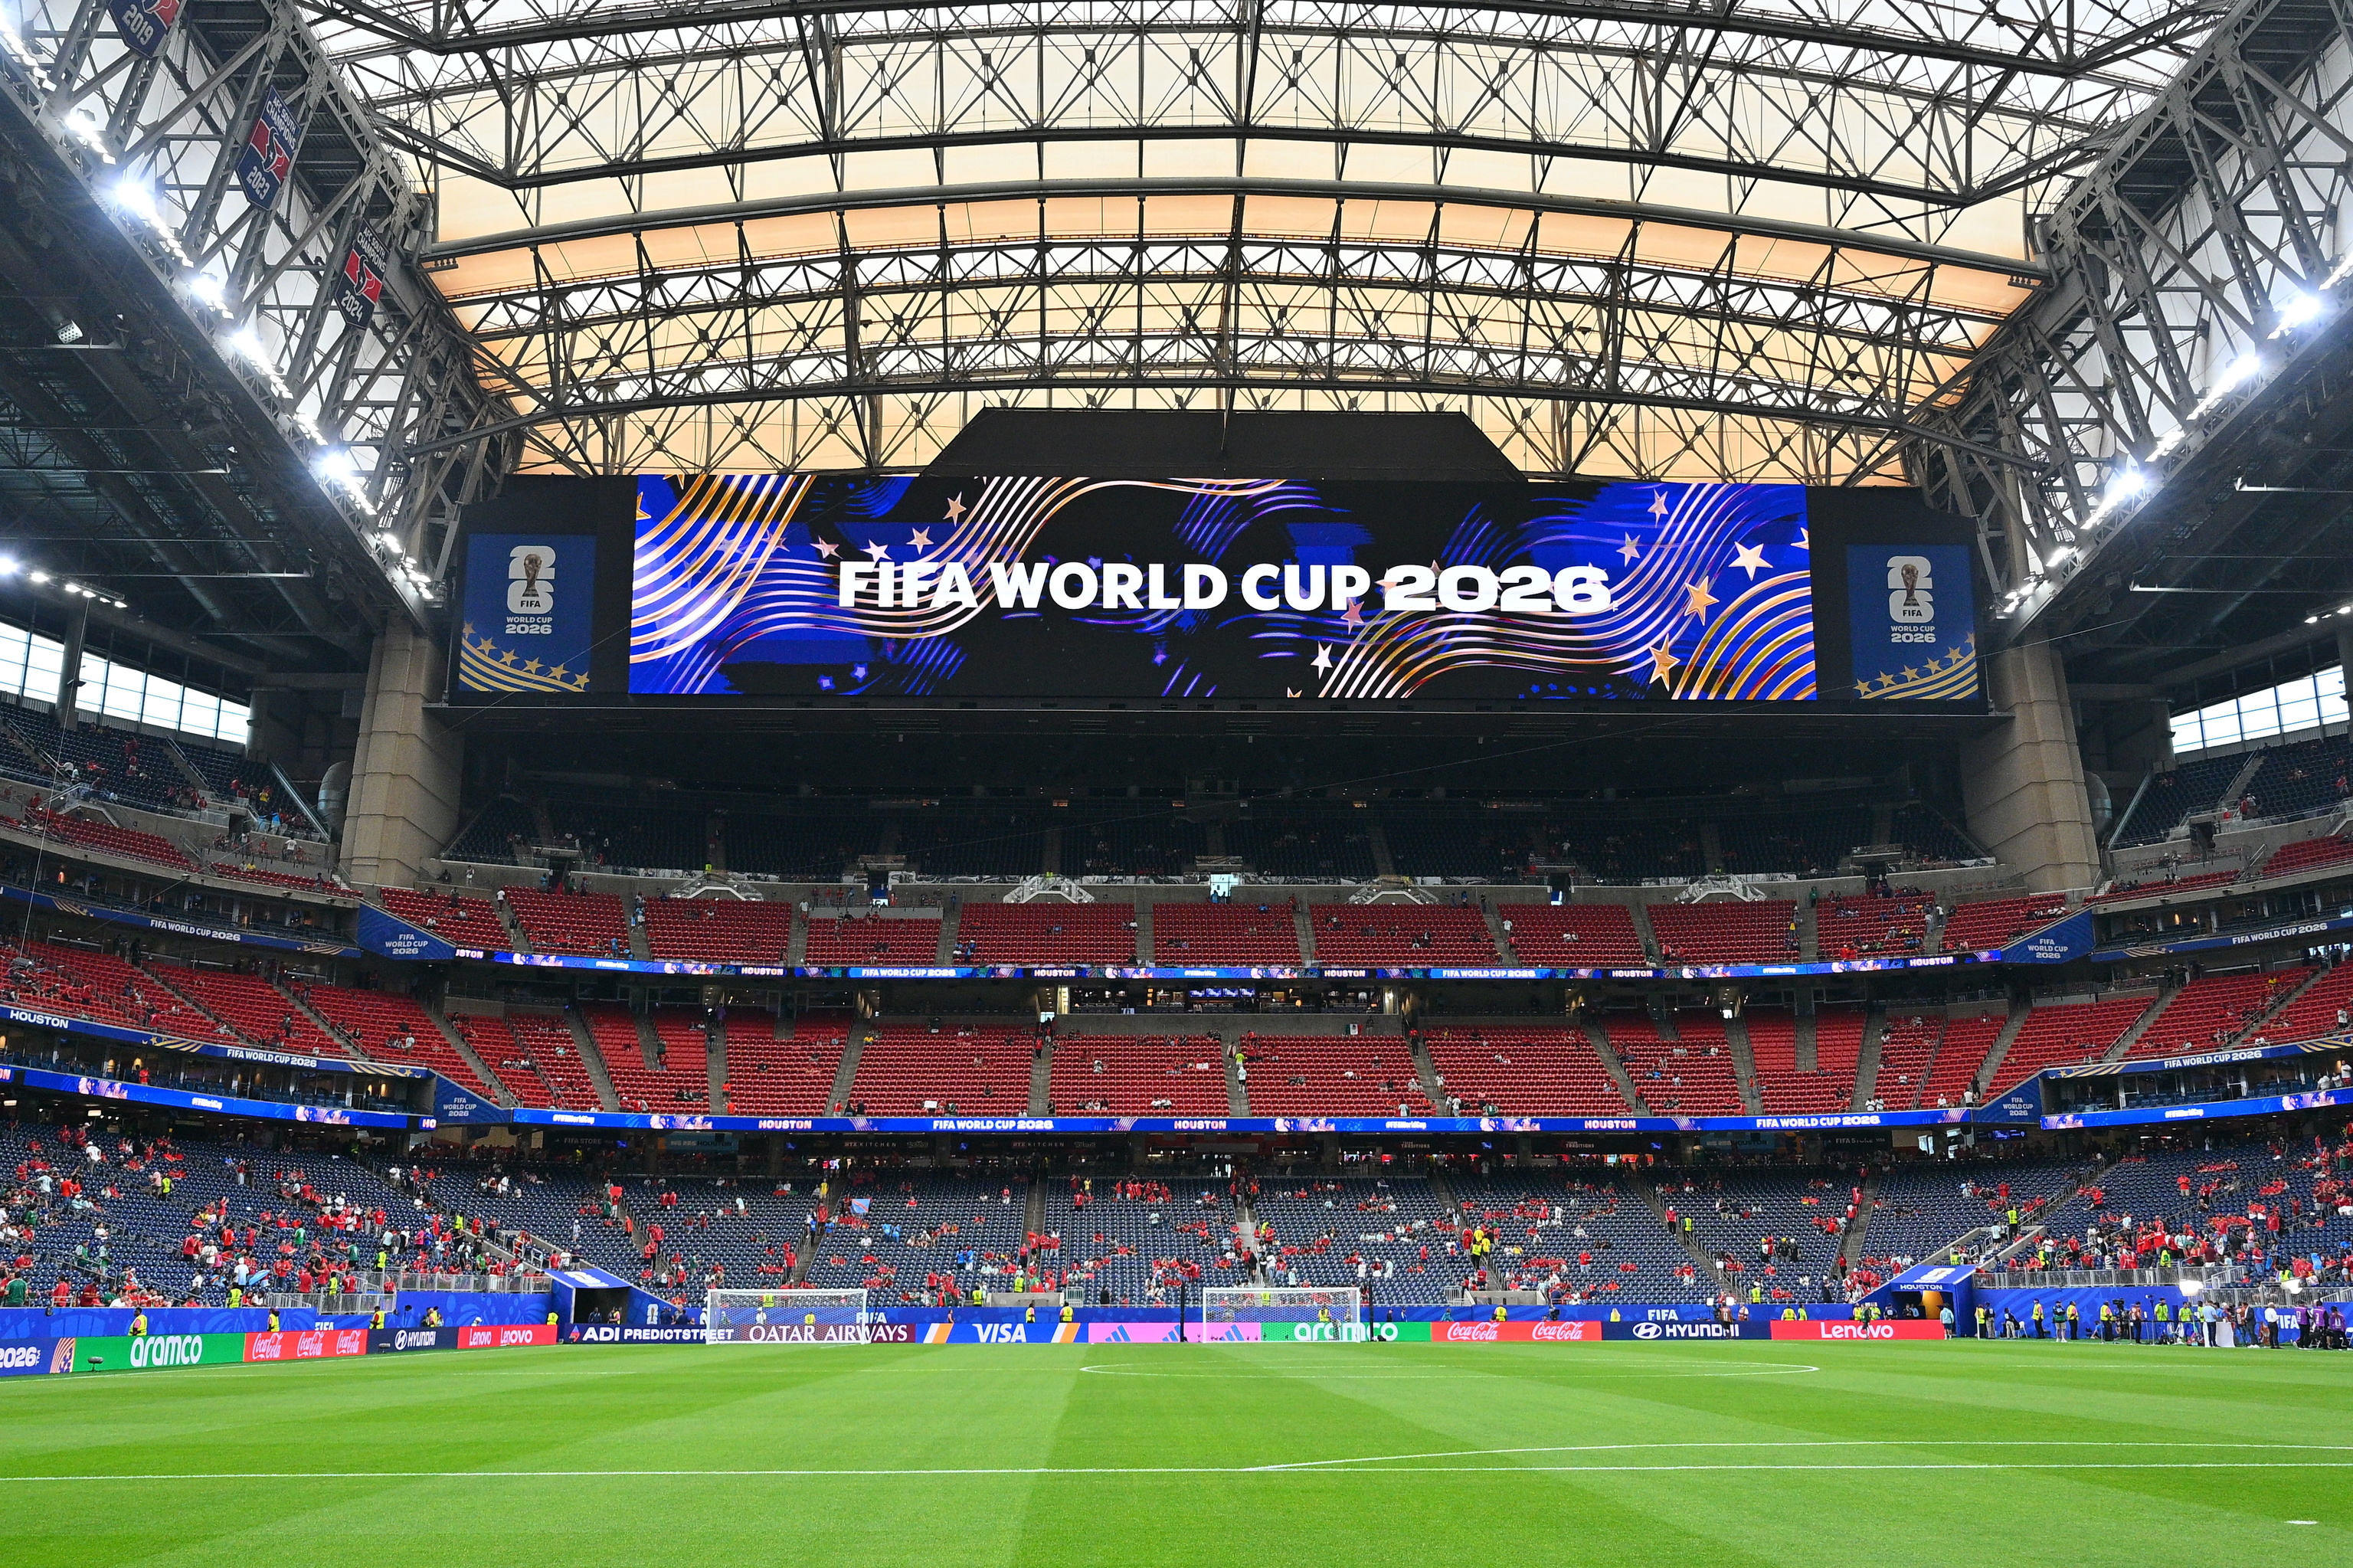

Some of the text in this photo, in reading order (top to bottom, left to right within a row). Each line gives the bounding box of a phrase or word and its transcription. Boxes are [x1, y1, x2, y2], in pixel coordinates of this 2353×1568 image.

[122, 4, 154, 46] 2019
[273, 96, 296, 133] AFC SOUTH
[267, 100, 296, 150] CHAMPIONS
[246, 165, 270, 201] 2023
[363, 227, 385, 259] AFC SOUTH
[357, 232, 387, 273] CHAMPIONS
[341, 290, 363, 322] 2024
[839, 561, 979, 608] FIFA
[990, 561, 1229, 610] WORLD
[1240, 562, 1372, 611] CUP
[1383, 564, 1612, 613] 2026
[520, 600, 541, 608] FIFA
[536, 616, 553, 624] CUP
[505, 624, 552, 634] 2026
[1890, 633, 1936, 643] 2026
[150, 919, 241, 941] FIFA WORLD CUP 2026
[2232, 922, 2328, 944] FIFA WORLD CUP 2026
[1910, 957, 1953, 967] HOUSTON
[741, 966, 784, 975] HOUSTON
[910, 969, 927, 977] CUP
[1034, 969, 1075, 977] HOUSTON
[10, 1010, 69, 1029] HOUSTON
[227, 1049, 317, 1068] FIFA WORLD CUP 2026
[2164, 1050, 2262, 1069] FIFA WORLD CUP 2026
[758, 1120, 812, 1129] HOUSTON
[933, 1120, 1054, 1129] FIFA WORLD CUP 2026
[1174, 1120, 1226, 1129] HOUSTON
[1585, 1120, 1636, 1129] HOUSTON
[1756, 1115, 1880, 1128] FIFA WORLD CUP 2026
[856, 1312, 887, 1324] FIFA
[1648, 1309, 1679, 1321] FIFA
[314, 1321, 334, 1331] FIFA
[582, 1327, 735, 1340] ADI PREDICTSTREET
[749, 1325, 908, 1341] QATAR AIRWAYS
[972, 1324, 1026, 1343] VISA
[1294, 1322, 1399, 1341] aramco
[1447, 1321, 1499, 1340] Coca-Cola
[1532, 1321, 1584, 1340] Coca-Cola
[1821, 1322, 1893, 1338] Lenovo
[407, 1331, 436, 1347] HYUNDAI
[469, 1327, 491, 1346] Lenovo
[499, 1329, 533, 1346] Lenovo
[130, 1334, 203, 1367] aramco
